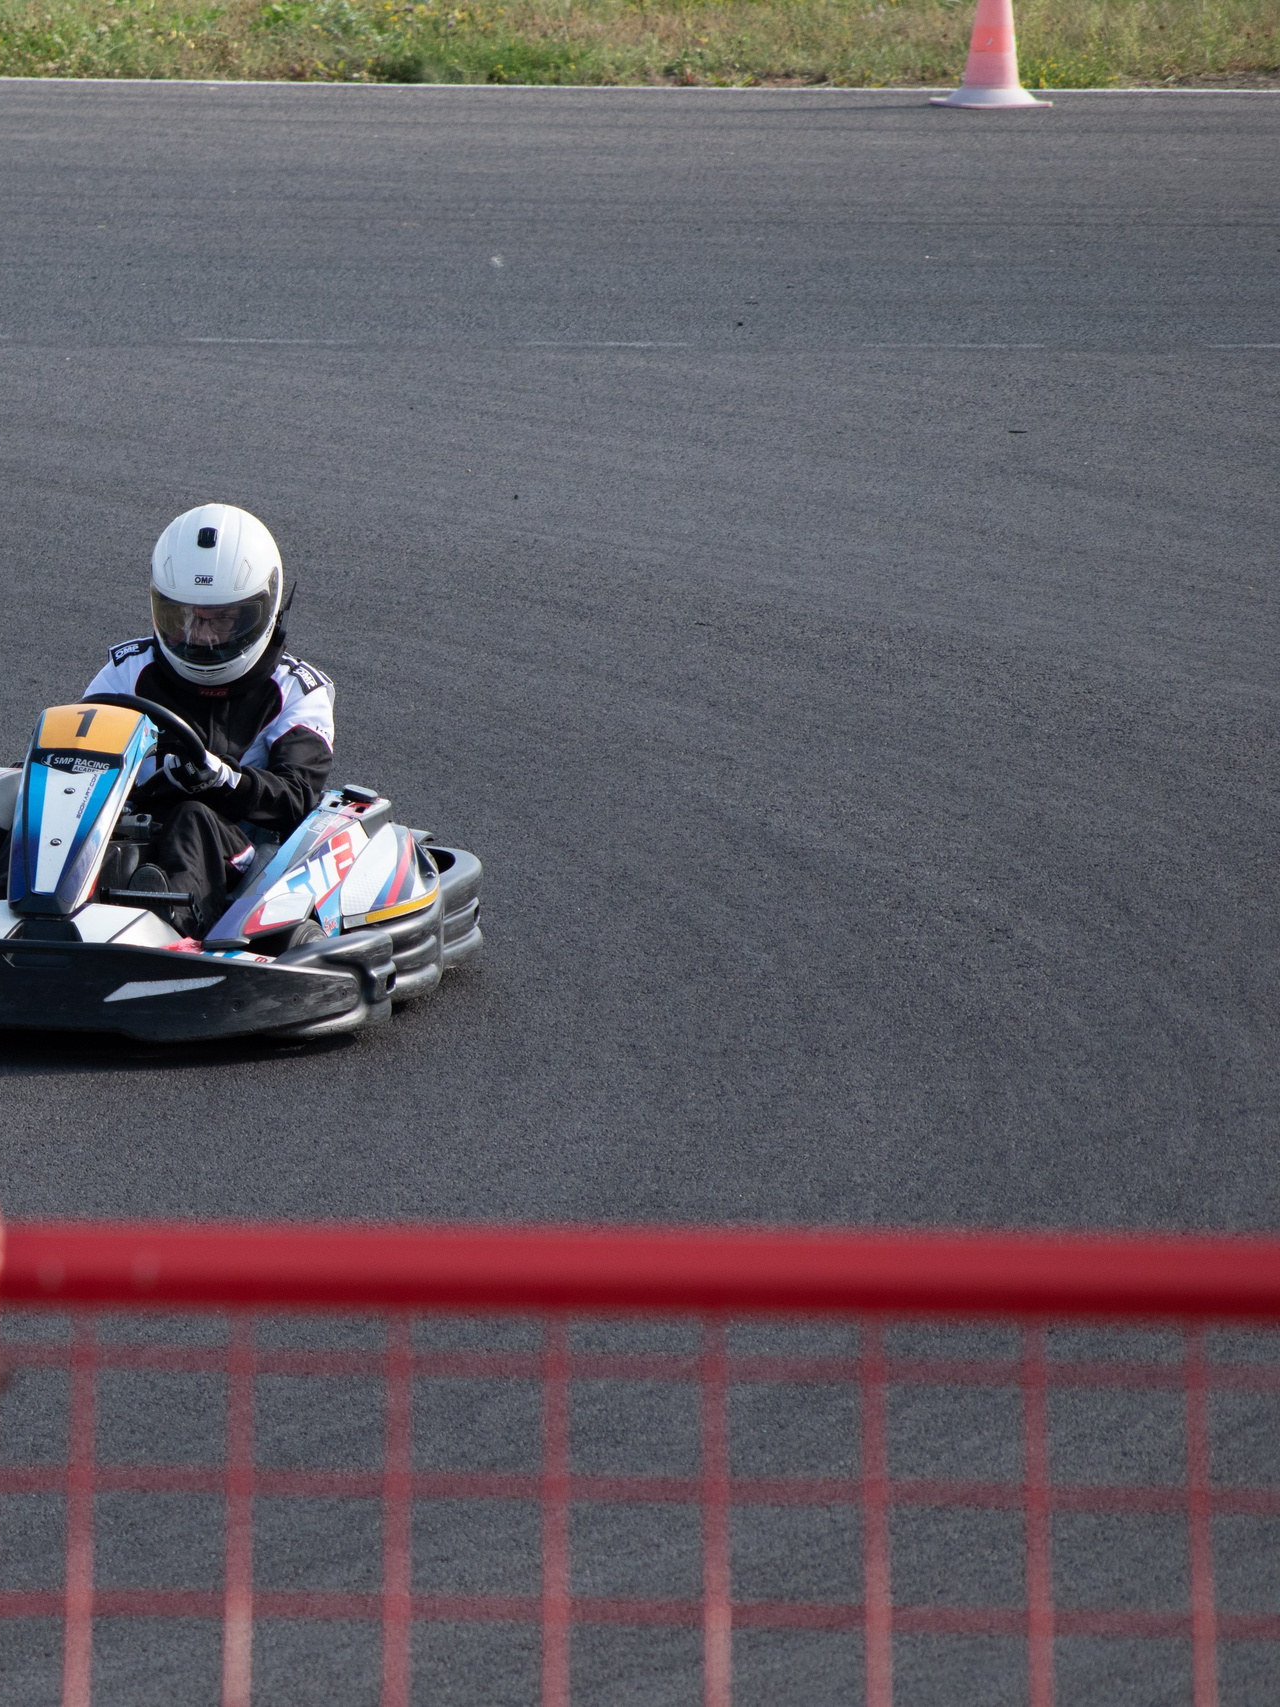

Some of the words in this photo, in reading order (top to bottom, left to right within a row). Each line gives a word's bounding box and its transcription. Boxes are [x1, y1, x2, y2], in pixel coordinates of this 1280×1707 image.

[194, 576, 213, 585] OMP
[114, 644, 138, 659] OMP
[293, 668, 315, 690] OMP
[75, 708, 97, 738] 1
[53, 757, 74, 765] SMP
[74, 757, 110, 770] RACING
